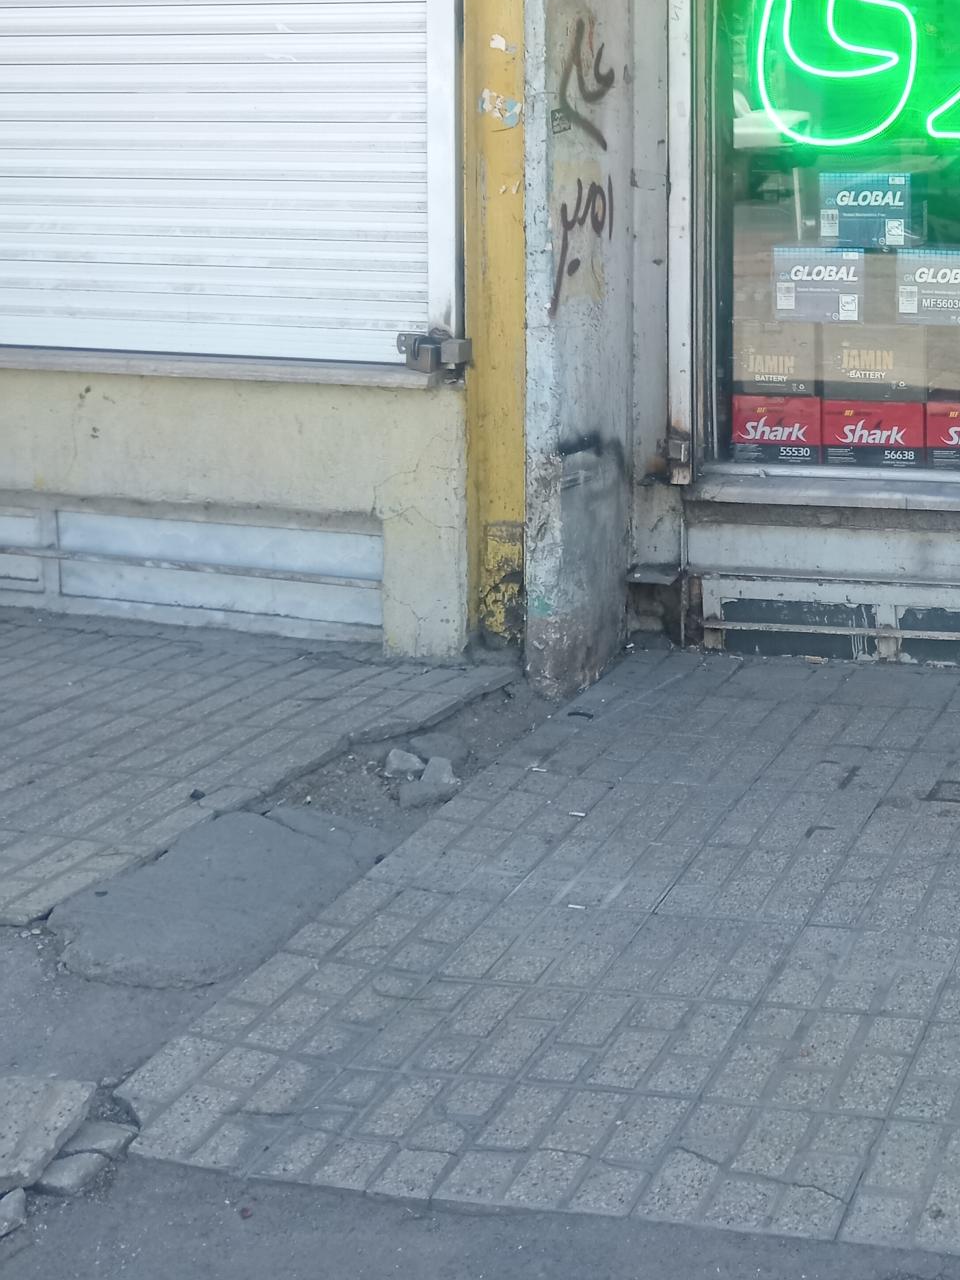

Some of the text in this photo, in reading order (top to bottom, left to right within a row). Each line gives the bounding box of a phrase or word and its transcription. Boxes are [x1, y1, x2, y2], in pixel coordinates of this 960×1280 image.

[836, 190, 905, 207] GLOBAL
[790, 265, 859, 282] GLOBAL
[754, 374, 788, 383] BATTERY
[849, 370, 887, 380] BATTERY
[738, 416, 809, 443] Shark
[834, 419, 907, 446] Shark
[779, 446, 811, 457] 55530
[884, 450, 916, 461] 56638
